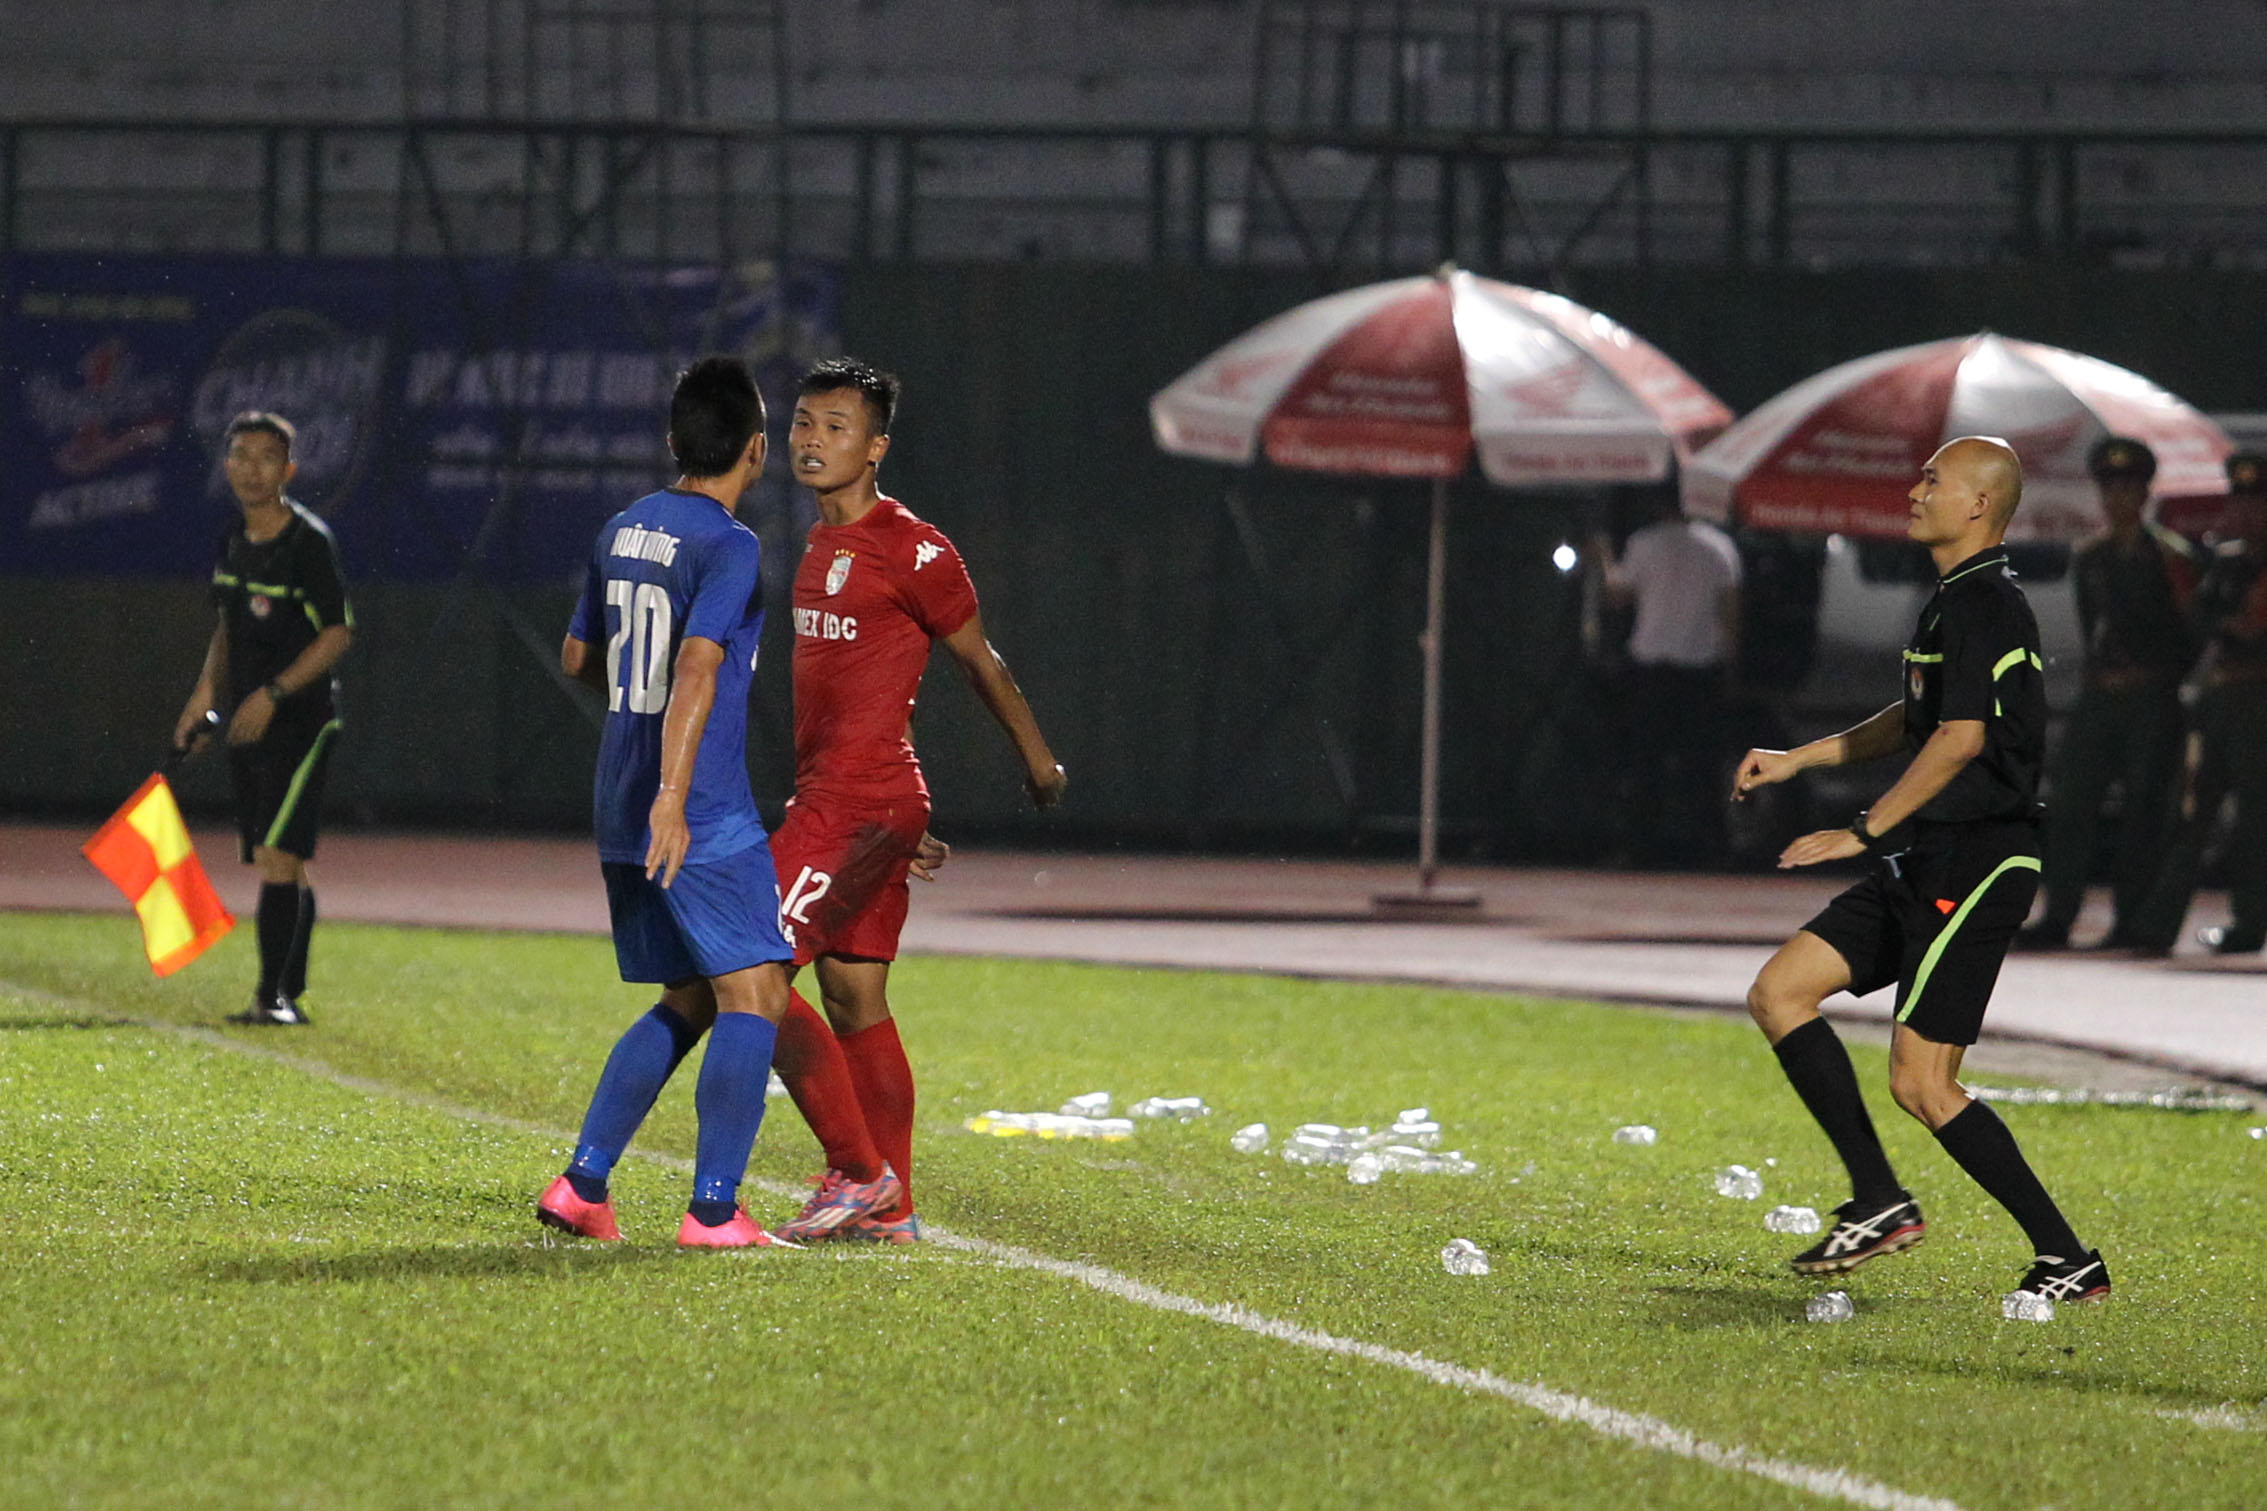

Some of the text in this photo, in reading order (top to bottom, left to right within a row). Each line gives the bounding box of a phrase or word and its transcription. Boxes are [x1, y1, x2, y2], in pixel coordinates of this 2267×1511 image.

[606, 579, 672, 714] 20
[823, 612, 858, 642] IDC
[782, 865, 832, 925] 12
